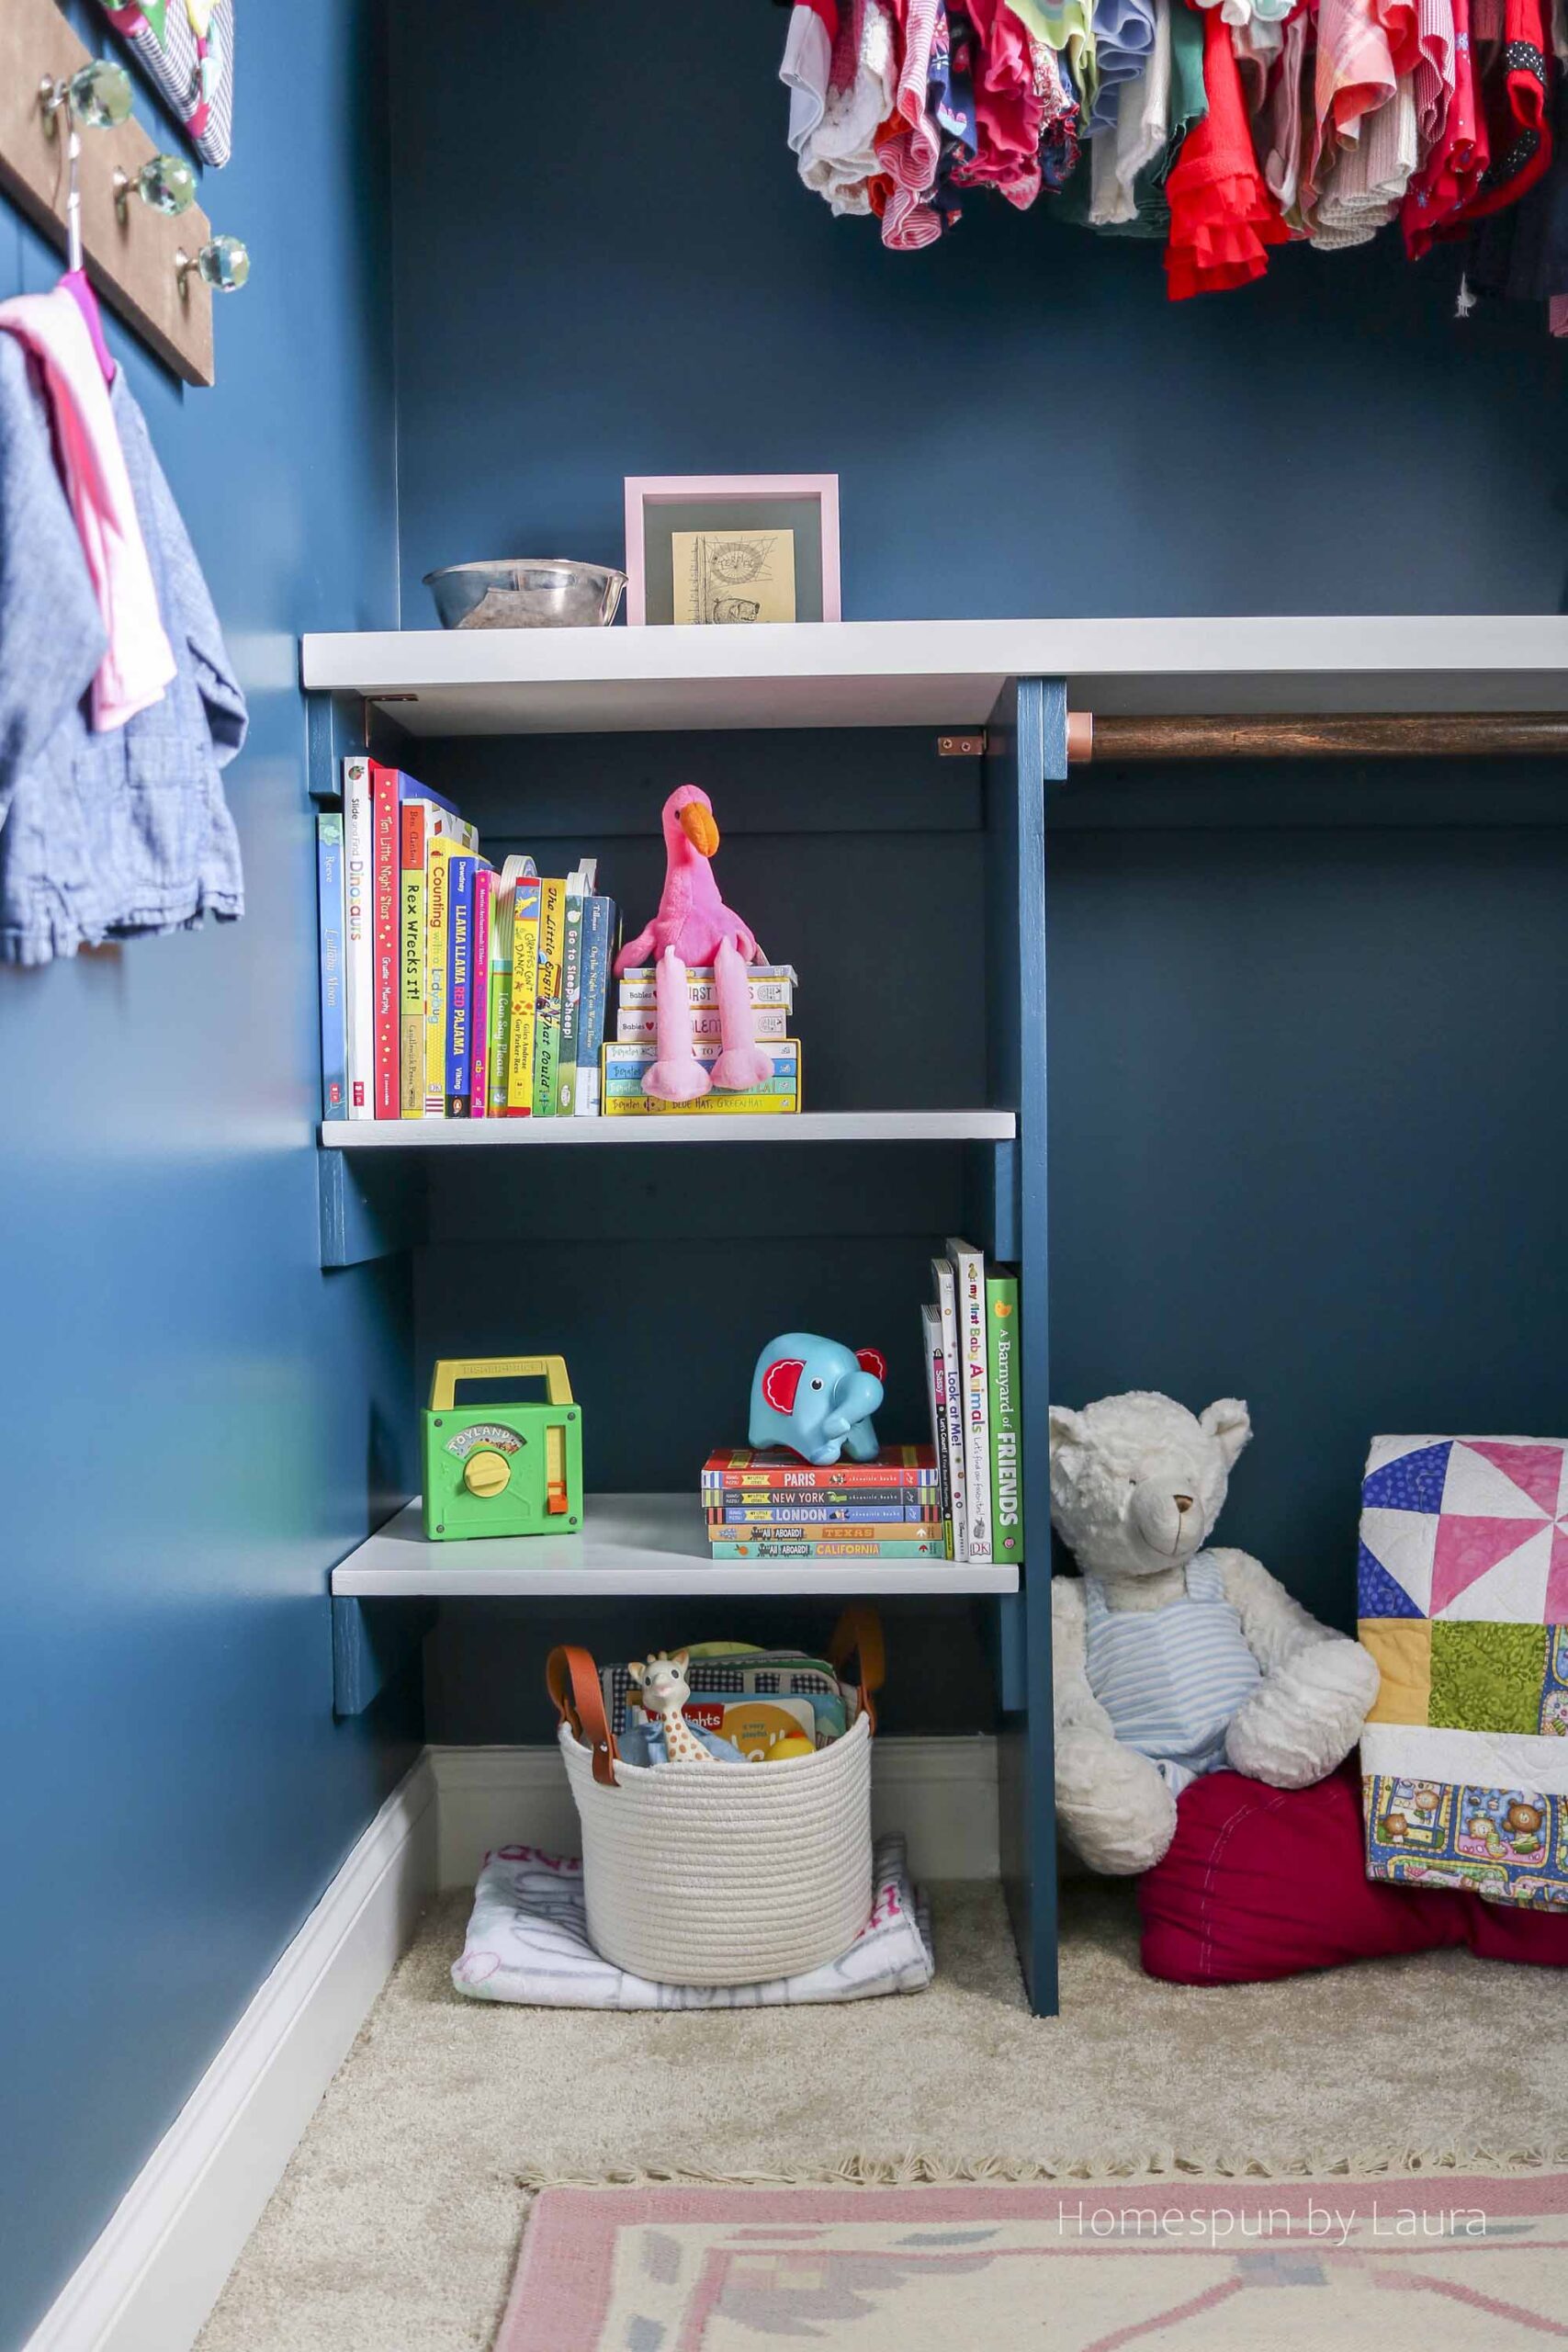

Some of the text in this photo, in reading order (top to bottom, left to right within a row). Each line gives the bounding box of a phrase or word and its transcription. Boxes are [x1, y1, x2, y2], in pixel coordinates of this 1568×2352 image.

[352, 798, 360, 820] Slide
[410, 810, 419, 827] Ben
[352, 837, 360, 856] Find
[325, 855, 335, 883] Reeve
[378, 818, 393, 921] Ten Little Night Stars
[457, 861, 467, 893] Dewdney
[350, 861, 364, 942] Dinosaurs
[407, 885, 420, 914] Rex
[430, 866, 445, 928] Counting
[591, 903, 601, 932] Tillman
[434, 932, 443, 953] with
[569, 930, 578, 944] Go
[514, 944, 525, 977] DANCE
[525, 933, 536, 969] GIRAFFES
[568, 948, 577, 961] to
[591, 945, 599, 957] On
[324, 929, 339, 1007] Lullaby Moon
[454, 905, 467, 1056] LLAMA LLAMA RED PAJAMA
[540, 888, 557, 1088] The Little Engine That Could
[588, 972, 598, 991] Night
[380, 986, 391, 1015] Murphy
[428, 968, 445, 1024] Ladybug
[589, 994, 597, 1006] You
[629, 991, 652, 1000] Babies
[689, 986, 712, 1001] IRST
[498, 998, 509, 1018] Can
[562, 1001, 574, 1039] Sheep!
[588, 1009, 596, 1029] Were
[492, 1021, 508, 1040] Say
[524, 1023, 532, 1039] Giles
[587, 1030, 595, 1048] Born
[496, 1043, 508, 1078] Please
[513, 1033, 522, 1074] Parker-Rees
[702, 1047, 714, 1056] TO
[454, 1068, 463, 1090] Viking
[672, 1101, 692, 1109] BLUE
[716, 1098, 747, 1109] GREEN
[748, 1098, 764, 1108] HAT
[967, 1283, 986, 1433] my first Baby Animals
[935, 1369, 944, 1393] Sassy
[947, 1371, 962, 1447] Look at Me!
[939, 1418, 947, 1432] Let's
[996, 1329, 1019, 1527] A Barnyard of FRIENDS
[447, 1426, 511, 1451] TOYLAND
[940, 1432, 948, 1453] Count!
[974, 1436, 983, 1454] Let's
[973, 1455, 984, 1470] find
[784, 1473, 816, 1487] PARIS
[773, 1492, 825, 1503] NEW YORK
[973, 1484, 986, 1517] favorites!
[776, 1509, 827, 1521] LONDON
[775, 1528, 802, 1538] ABOARD!
[825, 1529, 874, 1537] TEXAS
[782, 1544, 808, 1555] ABOARD!
[816, 1544, 879, 1555] CALIFORNIA
[973, 1543, 990, 1555] DK
